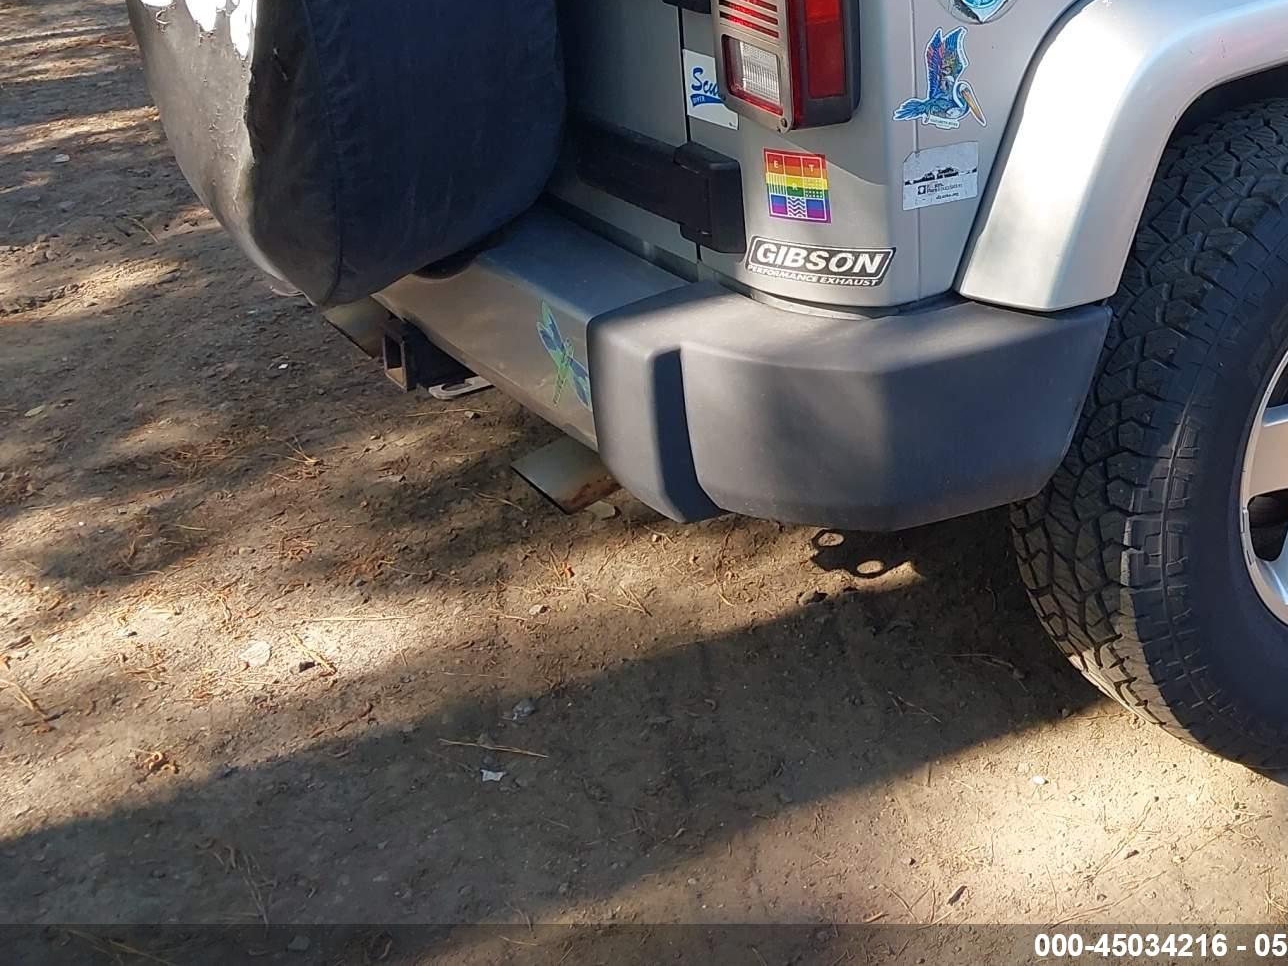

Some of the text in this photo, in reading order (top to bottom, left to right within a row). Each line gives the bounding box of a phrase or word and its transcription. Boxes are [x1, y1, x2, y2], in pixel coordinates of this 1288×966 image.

[755, 243, 884, 274] GIBSON
[748, 264, 879, 287] PERFORMANCE EXHAUST
